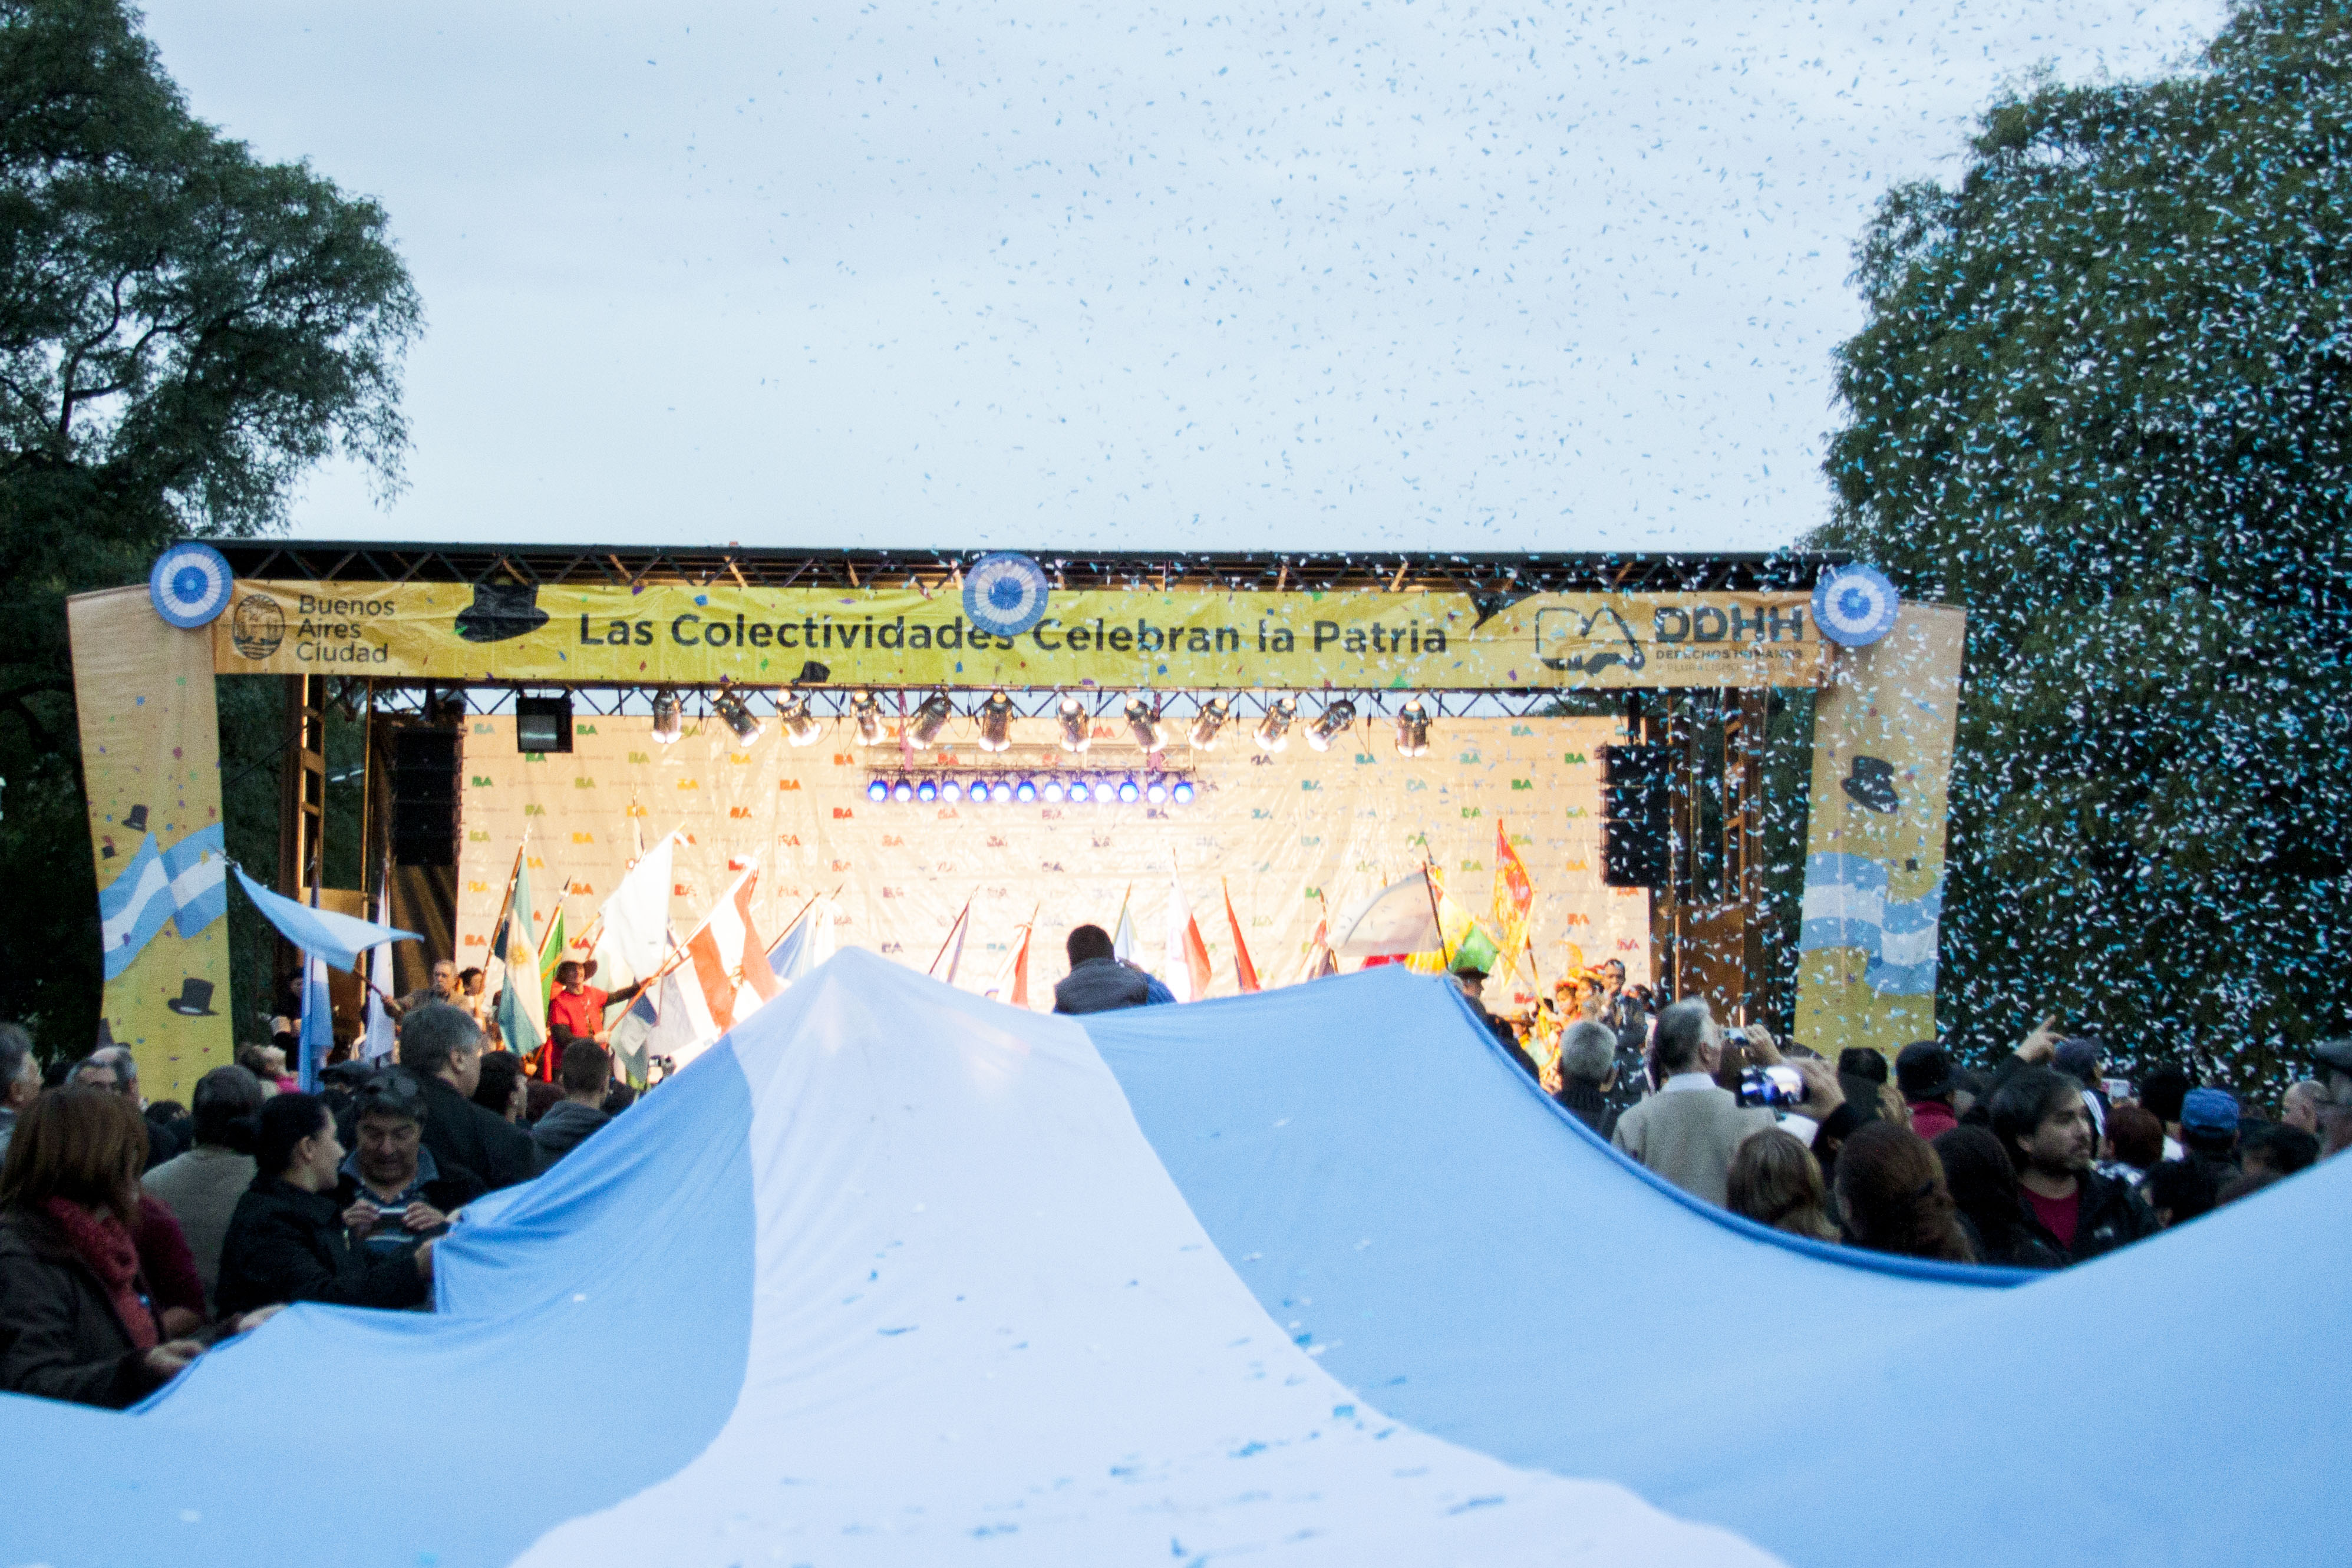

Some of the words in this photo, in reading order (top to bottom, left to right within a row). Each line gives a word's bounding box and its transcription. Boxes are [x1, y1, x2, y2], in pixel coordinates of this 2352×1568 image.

[298, 594, 395, 616] Buenos
[296, 619, 362, 639] Aires
[1655, 606, 1803, 643] DDHH
[580, 613, 654, 646] Las
[671, 613, 1015, 650] Colectividades
[1032, 617, 1238, 652] Celebran
[1258, 619, 1295, 653] la
[1313, 619, 1447, 654] Patria
[296, 643, 388, 664] Ciudad
[1565, 752, 1586, 764] BA
[472, 775, 493, 788] BA
[779, 779, 801, 791] BA
[1511, 779, 1533, 790] BA
[464, 935, 487, 946] BA
